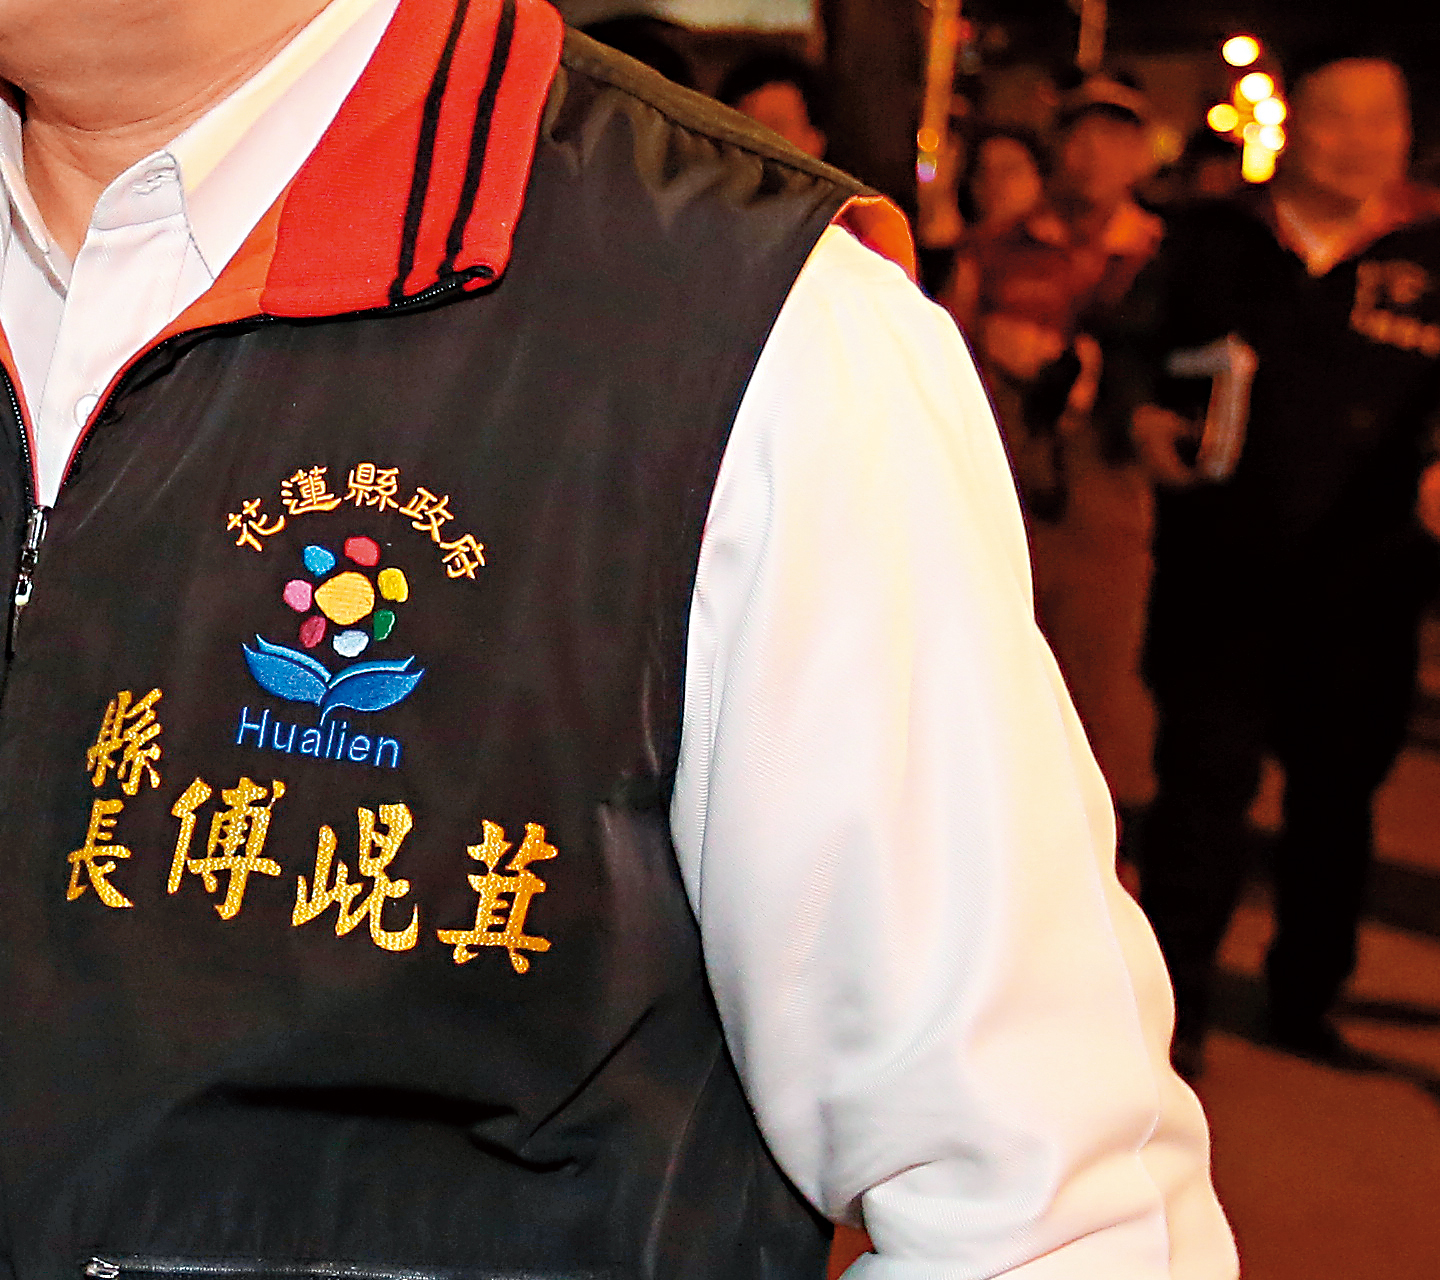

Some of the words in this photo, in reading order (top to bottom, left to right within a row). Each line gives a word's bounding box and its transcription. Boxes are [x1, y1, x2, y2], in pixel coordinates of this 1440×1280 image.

[226, 462, 486, 580] 花蓮縣政府
[235, 705, 401, 769] Hualien
[66, 688, 163, 909] 縣長
